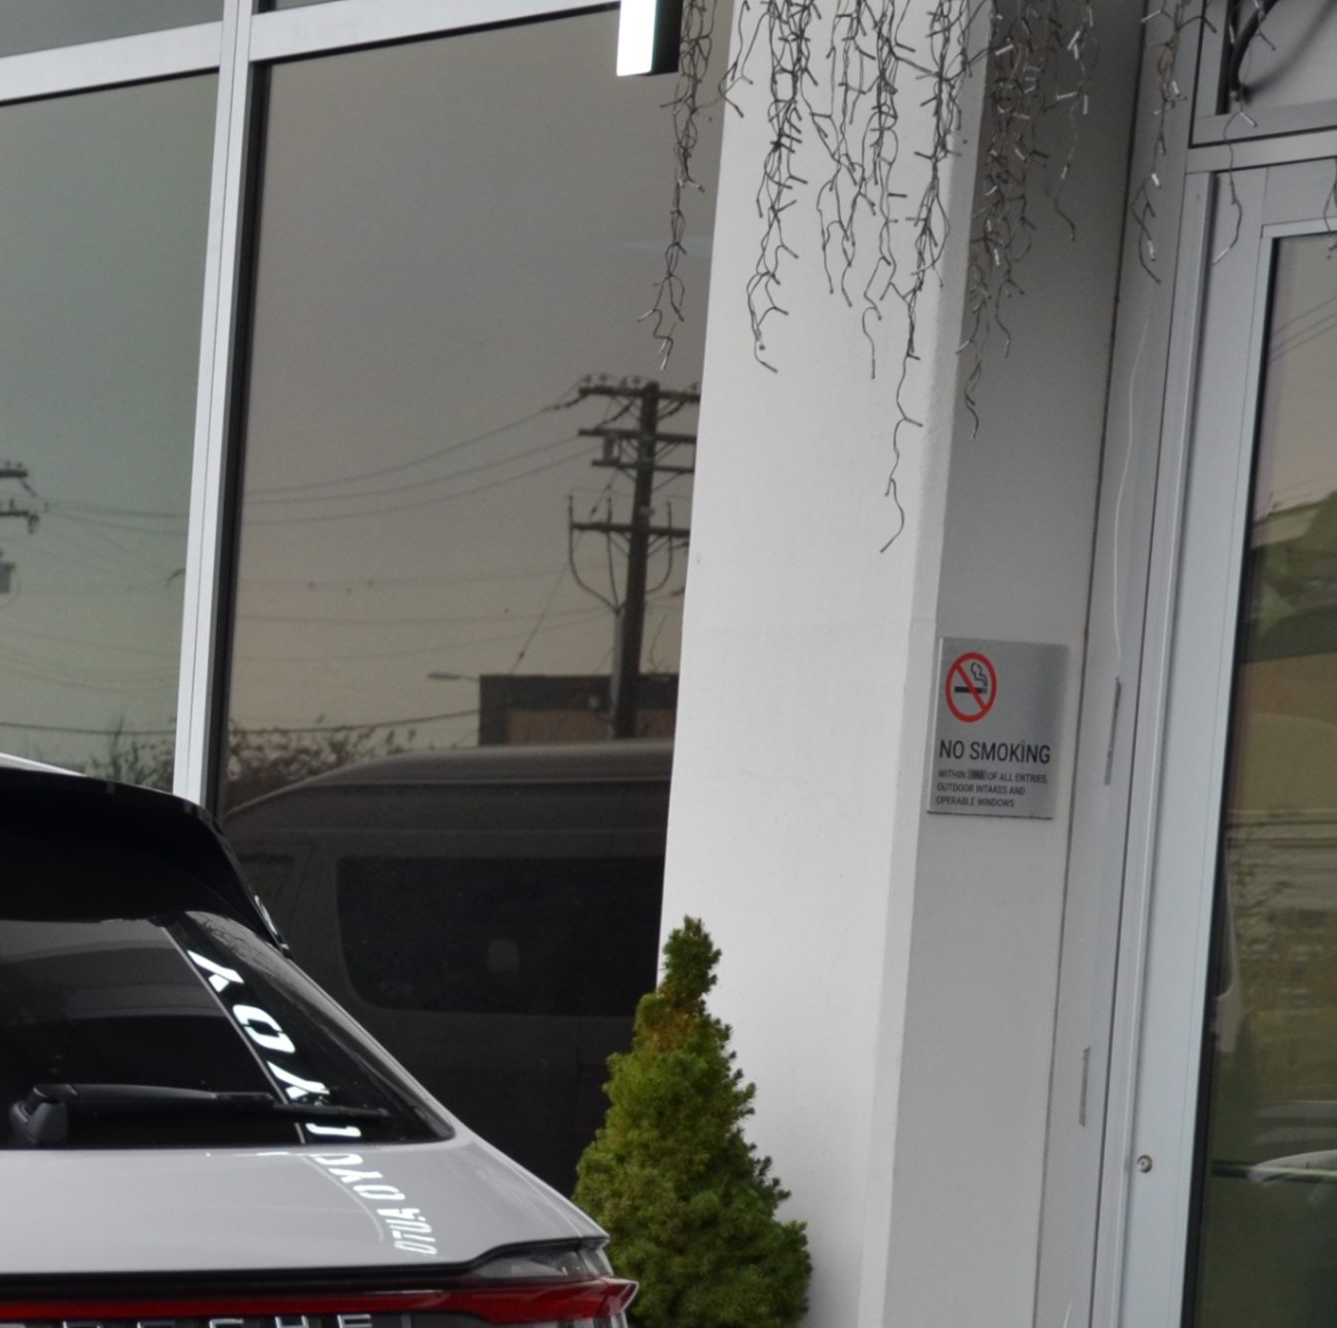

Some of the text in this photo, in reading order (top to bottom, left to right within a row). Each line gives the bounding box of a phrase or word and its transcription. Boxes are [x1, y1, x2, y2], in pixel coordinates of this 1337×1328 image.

[939, 739, 1051, 764] NO SMOKING
[938, 769, 966, 779] WITHIN
[987, 771, 998, 780] OF
[1000, 772, 1013, 782] ALL
[937, 782, 1025, 795] OUTDOOR INTAKES AND
[936, 795, 1014, 808] OPERABLE WINDOWS
